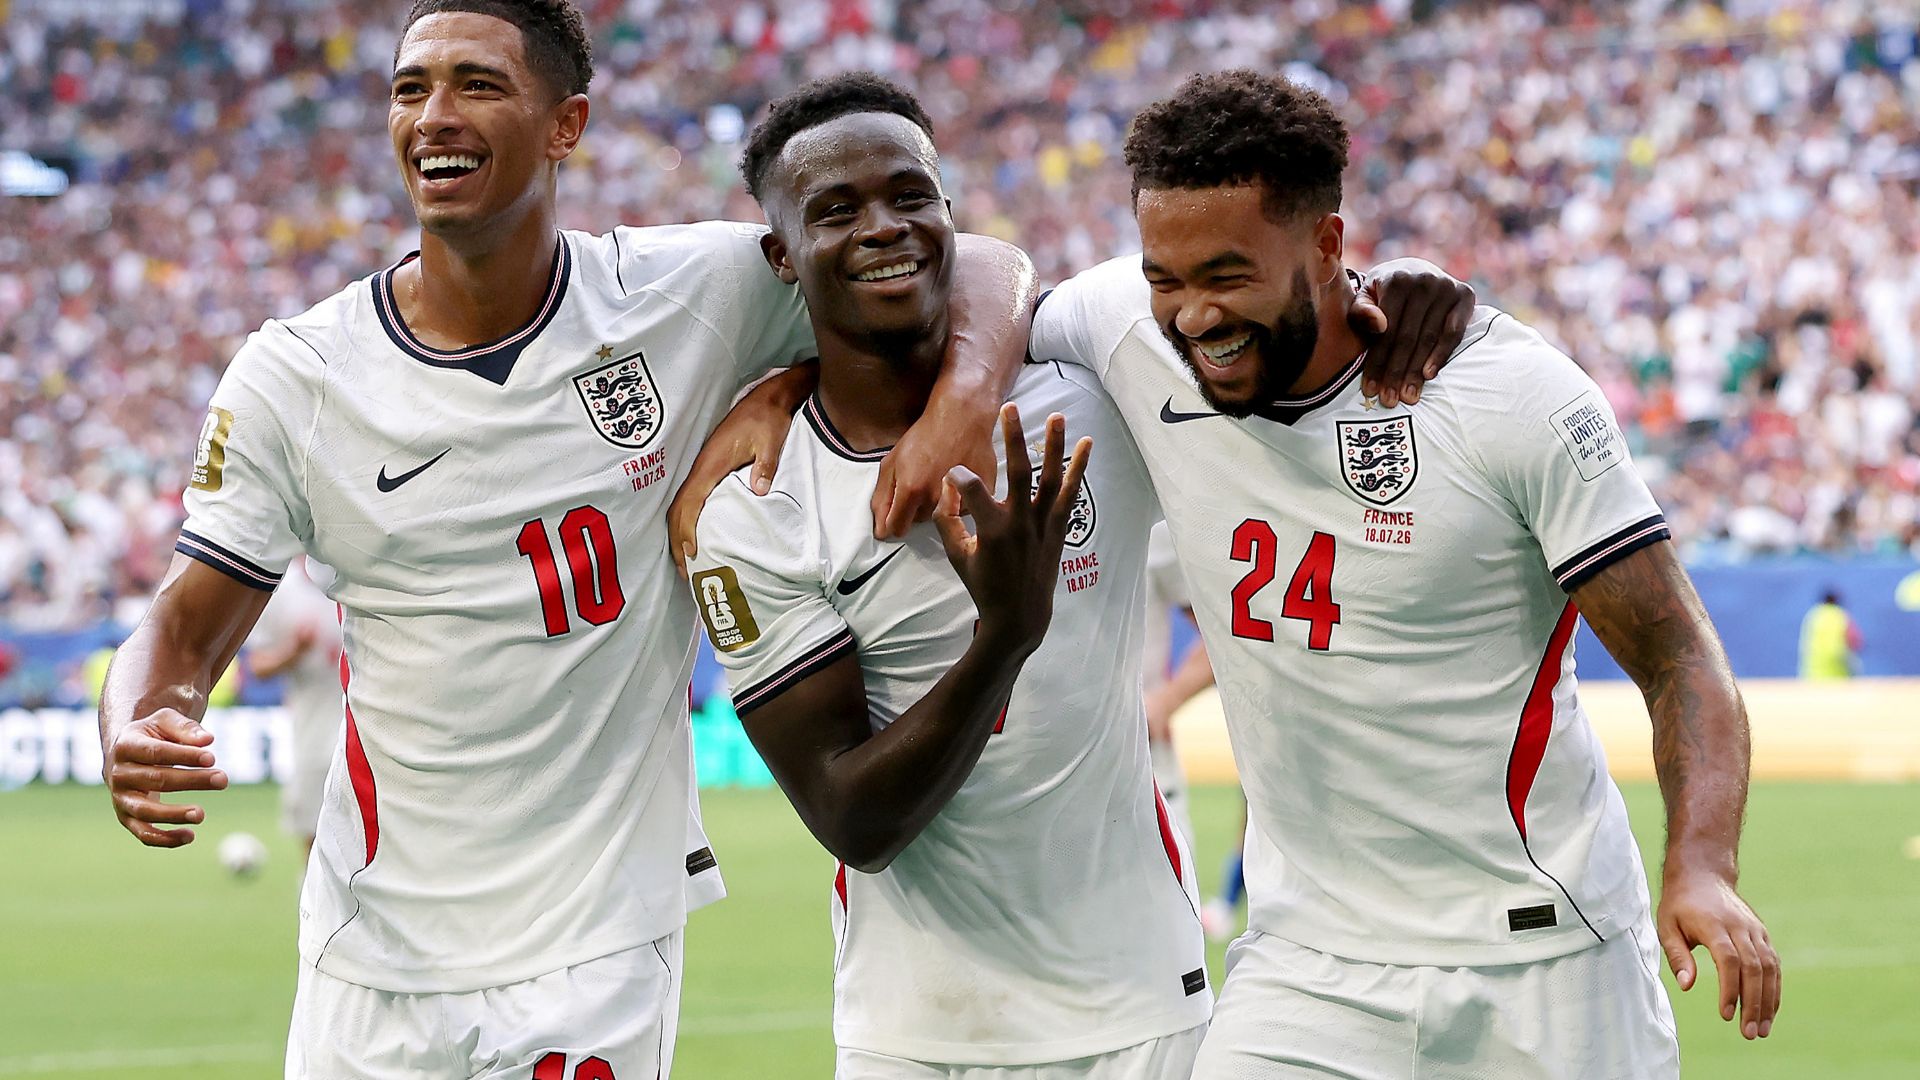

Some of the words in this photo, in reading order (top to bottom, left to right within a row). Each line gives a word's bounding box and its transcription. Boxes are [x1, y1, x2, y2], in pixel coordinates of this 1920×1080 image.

[1563, 402, 1598, 430] FOOTBALL
[1570, 413, 1607, 445] UNITES
[623, 447, 666, 476] FRANCE
[1578, 445, 1596, 460] the
[1597, 449, 1612, 462] FIFA
[632, 464, 666, 492] 18.07.26
[1364, 509, 1414, 526] FRANCE
[1365, 528, 1411, 544] 18.07.26
[516, 505, 626, 637] 10
[1061, 552, 1099, 575] FRANCE
[1230, 518, 1341, 651] 24
[718, 634, 744, 646] 2026
